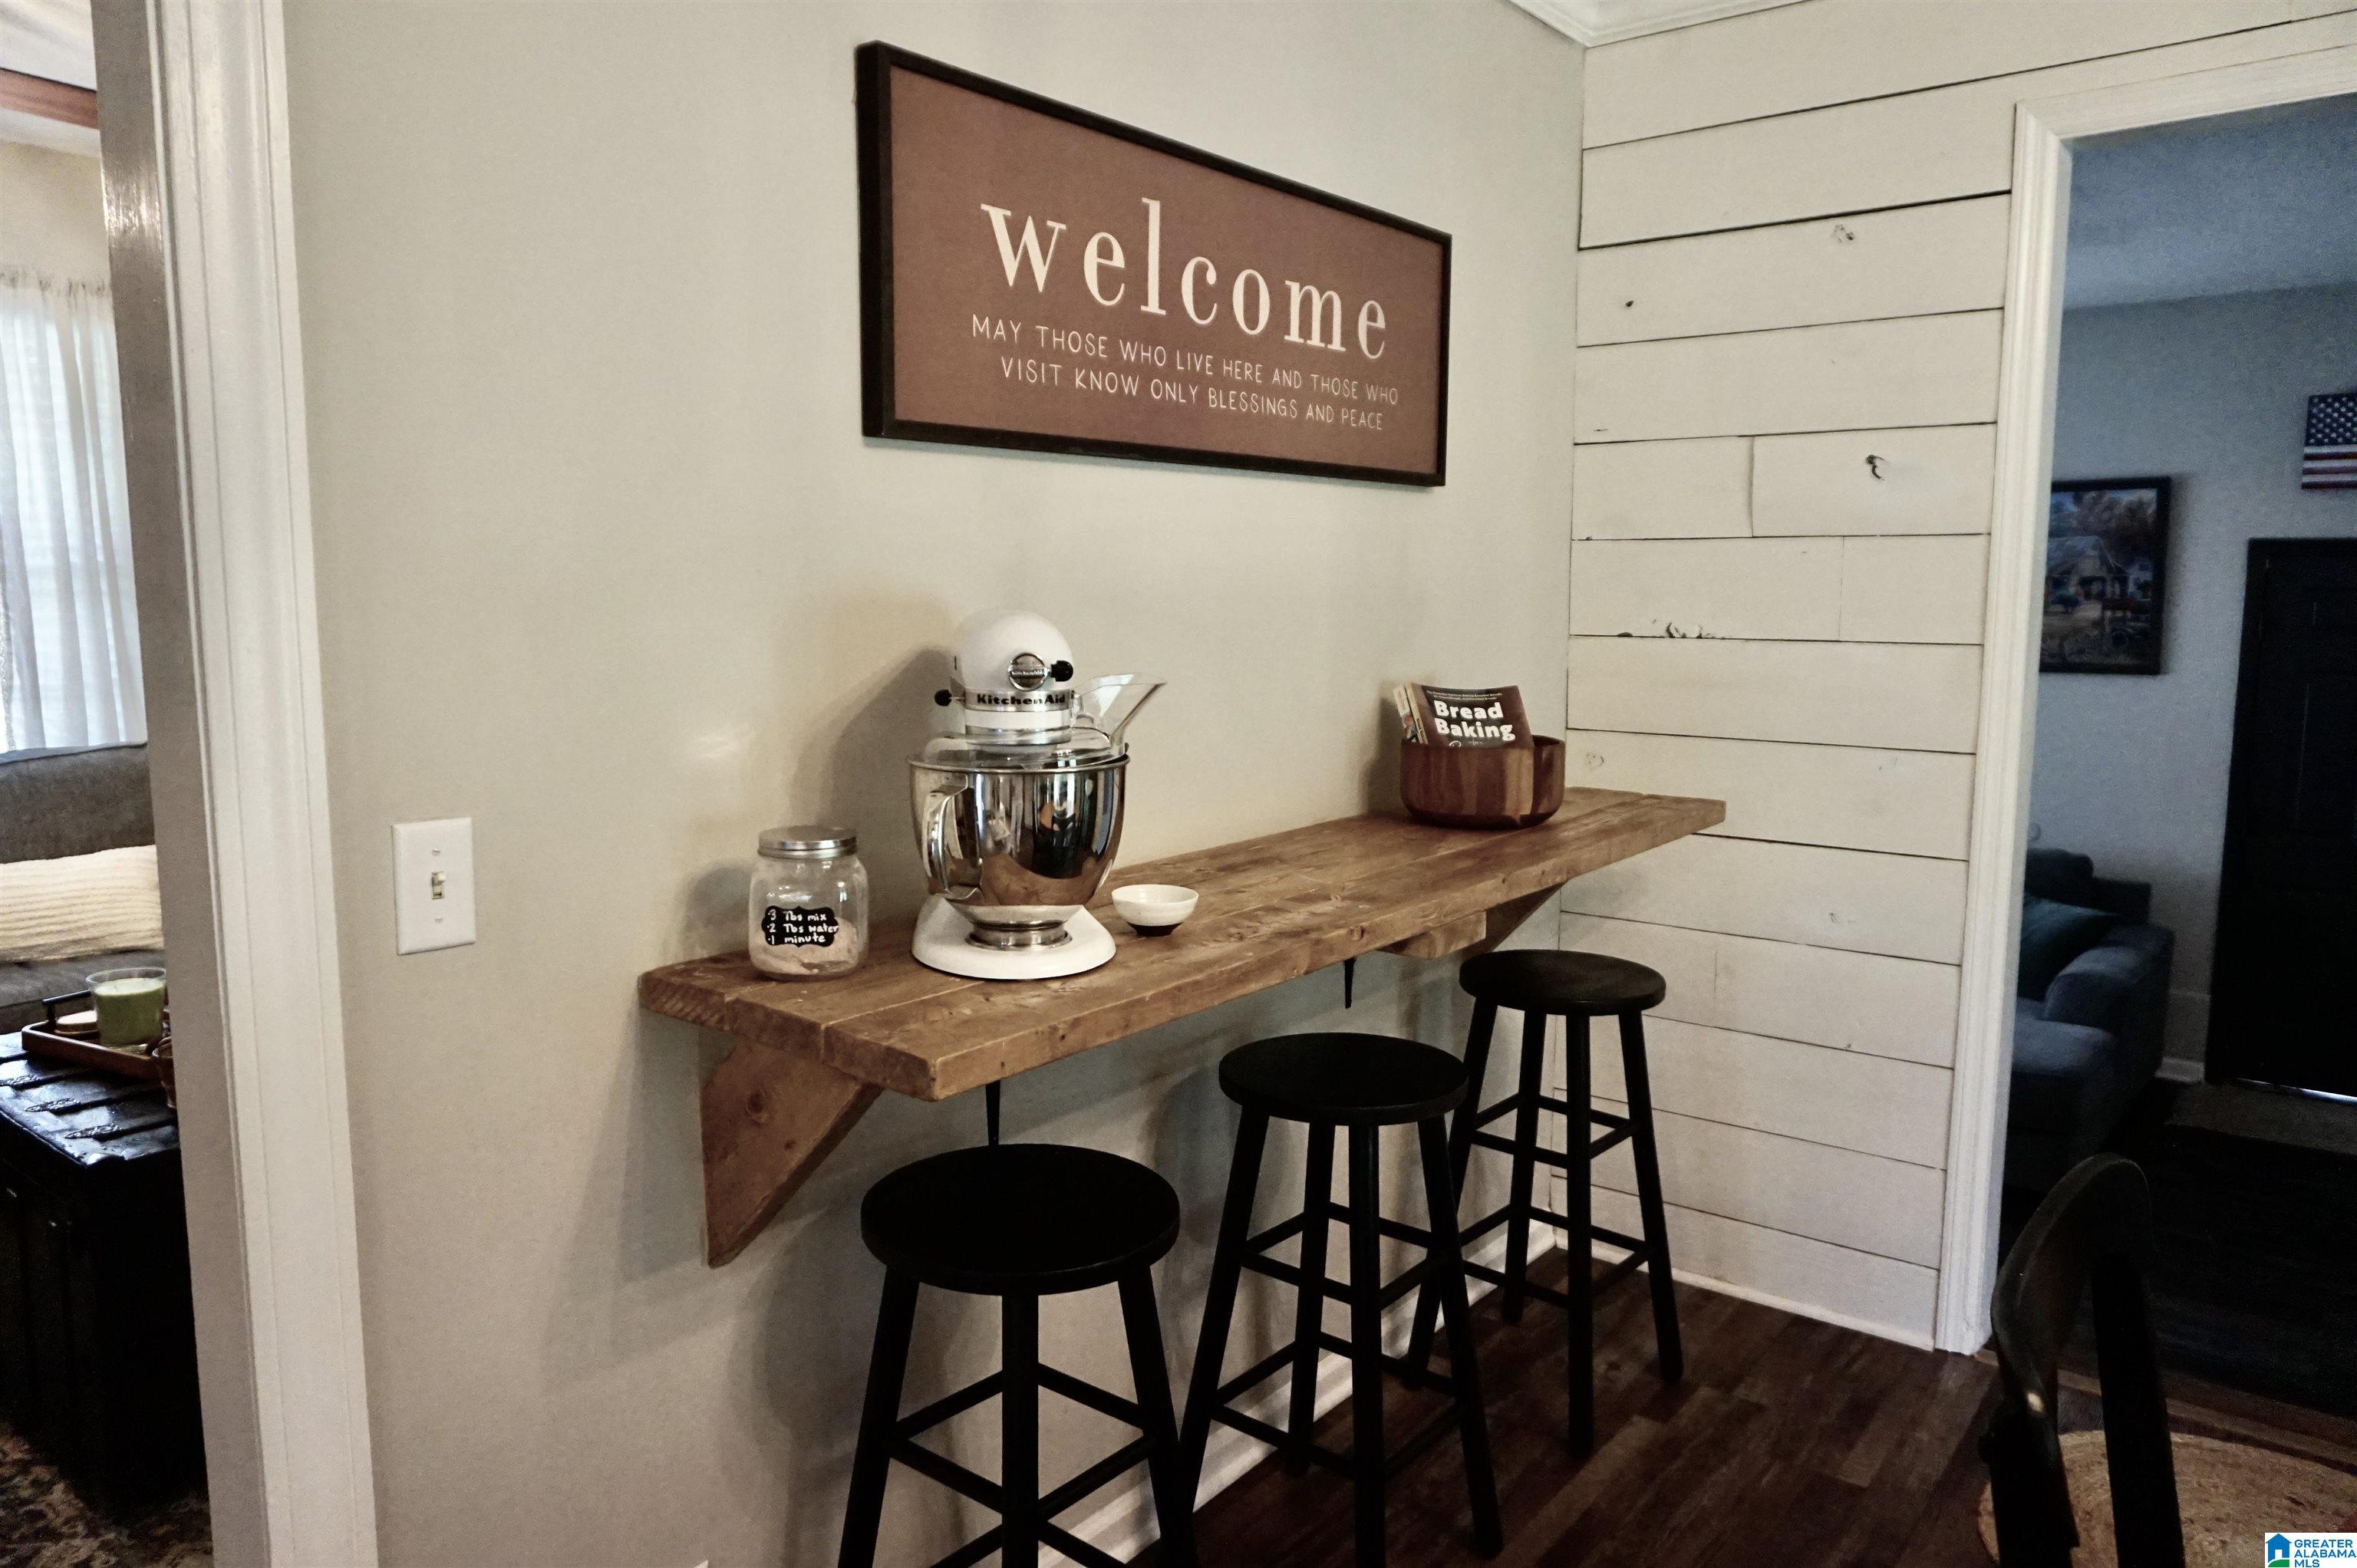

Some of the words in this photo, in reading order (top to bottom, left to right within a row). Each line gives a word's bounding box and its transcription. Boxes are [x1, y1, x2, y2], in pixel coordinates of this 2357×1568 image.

[981, 197, 1386, 360] welcome
[972, 313, 1022, 344] MAY
[1035, 324, 1108, 358] THOSE
[1119, 339, 1167, 367] WHO
[1176, 350, 1215, 376] LIVE
[1223, 358, 1263, 384] HERE
[1271, 368, 1303, 389] AND
[1310, 374, 1359, 400] THOSE
[1366, 383, 1399, 406] WHO
[1000, 356, 1063, 386] VISIT
[1075, 366, 1140, 397] KNOW
[1150, 378, 1199, 404] ONLY
[1208, 387, 1298, 419] BLESSINGS
[1305, 404, 1335, 423] AND
[1341, 407, 1384, 431] PEACE
[977, 694, 1066, 706] KitchenAid
[1433, 700, 1504, 720] Bread
[1434, 717, 1516, 742] Baking
[807, 913, 827, 921] mix
[783, 923, 803, 933] Tbs
[808, 923, 839, 933] water
[784, 931, 826, 944] minute
